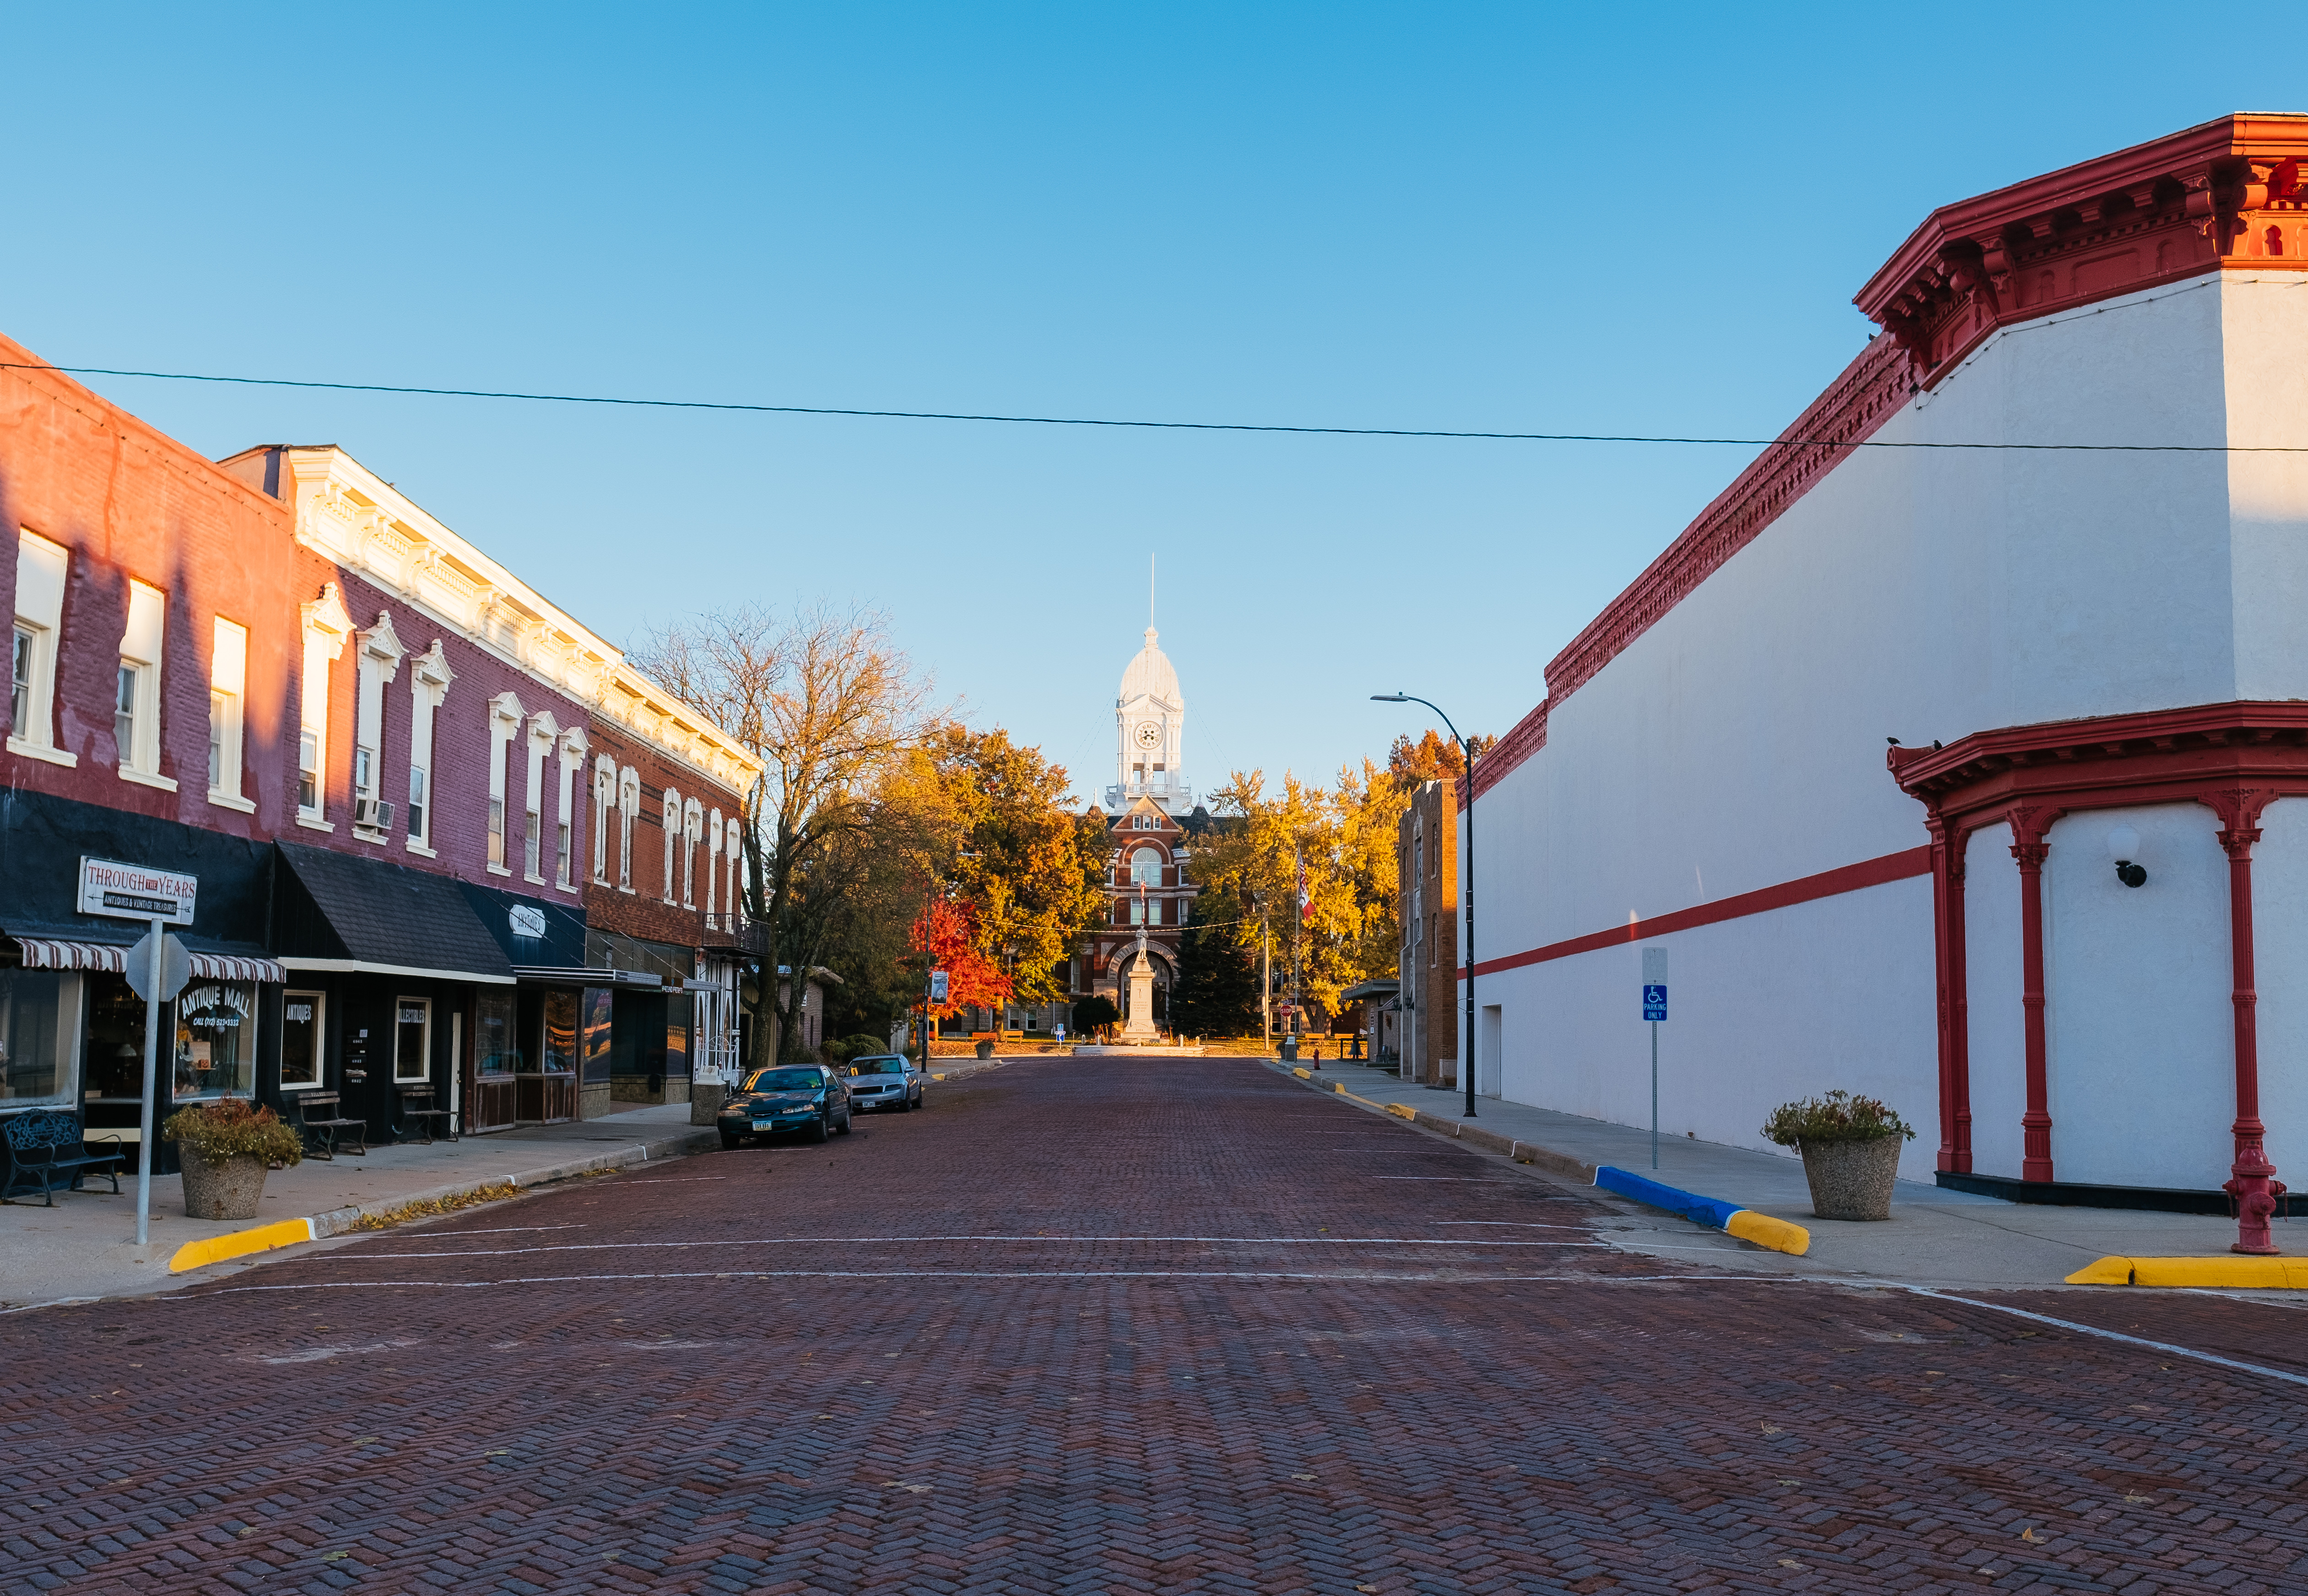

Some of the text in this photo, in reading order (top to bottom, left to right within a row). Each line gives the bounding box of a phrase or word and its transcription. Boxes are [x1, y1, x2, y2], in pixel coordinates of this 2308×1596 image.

[88, 866, 195, 898] THROUGH THE YEARS
[104, 894, 176, 913] ANTIQUES & VINTAGE TREASURES
[182, 986, 249, 1019] ANTIQUE MALL
[286, 1004, 312, 1024] ANTIQUES
[398, 1008, 425, 1023] OLLECTIBLES
